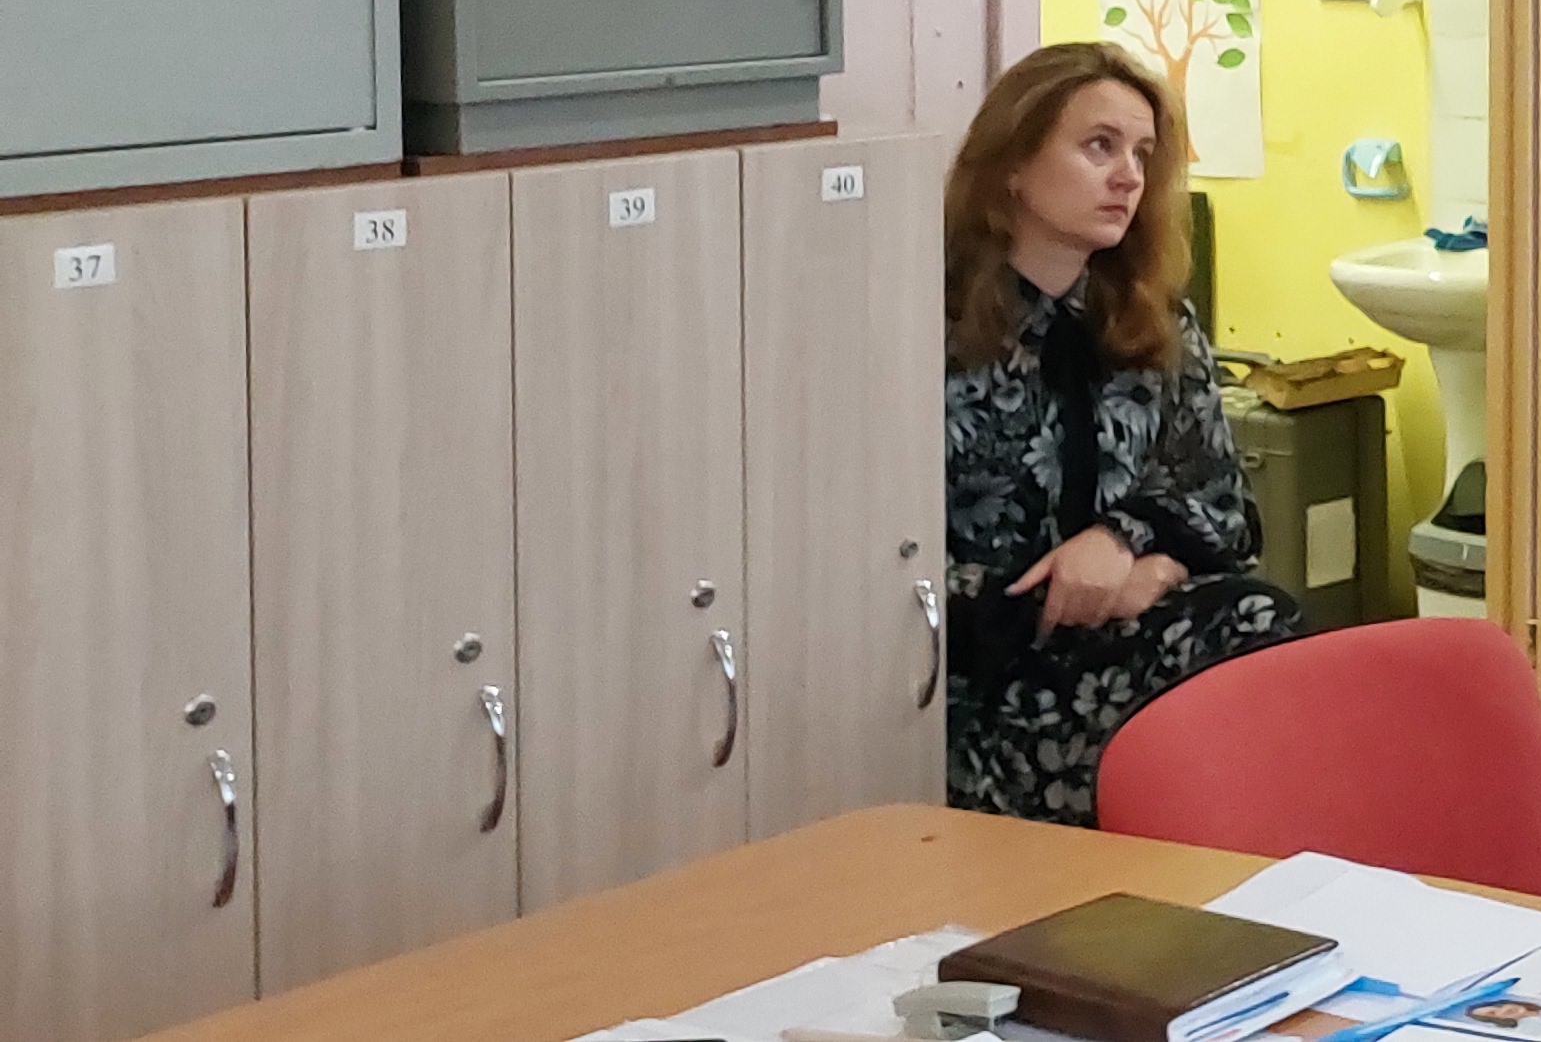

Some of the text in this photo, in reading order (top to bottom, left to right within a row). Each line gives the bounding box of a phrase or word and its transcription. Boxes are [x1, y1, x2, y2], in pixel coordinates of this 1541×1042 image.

[830, 174, 855, 194] 40
[620, 196, 646, 221] 39
[365, 219, 394, 244] 38
[69, 254, 101, 282] 37
